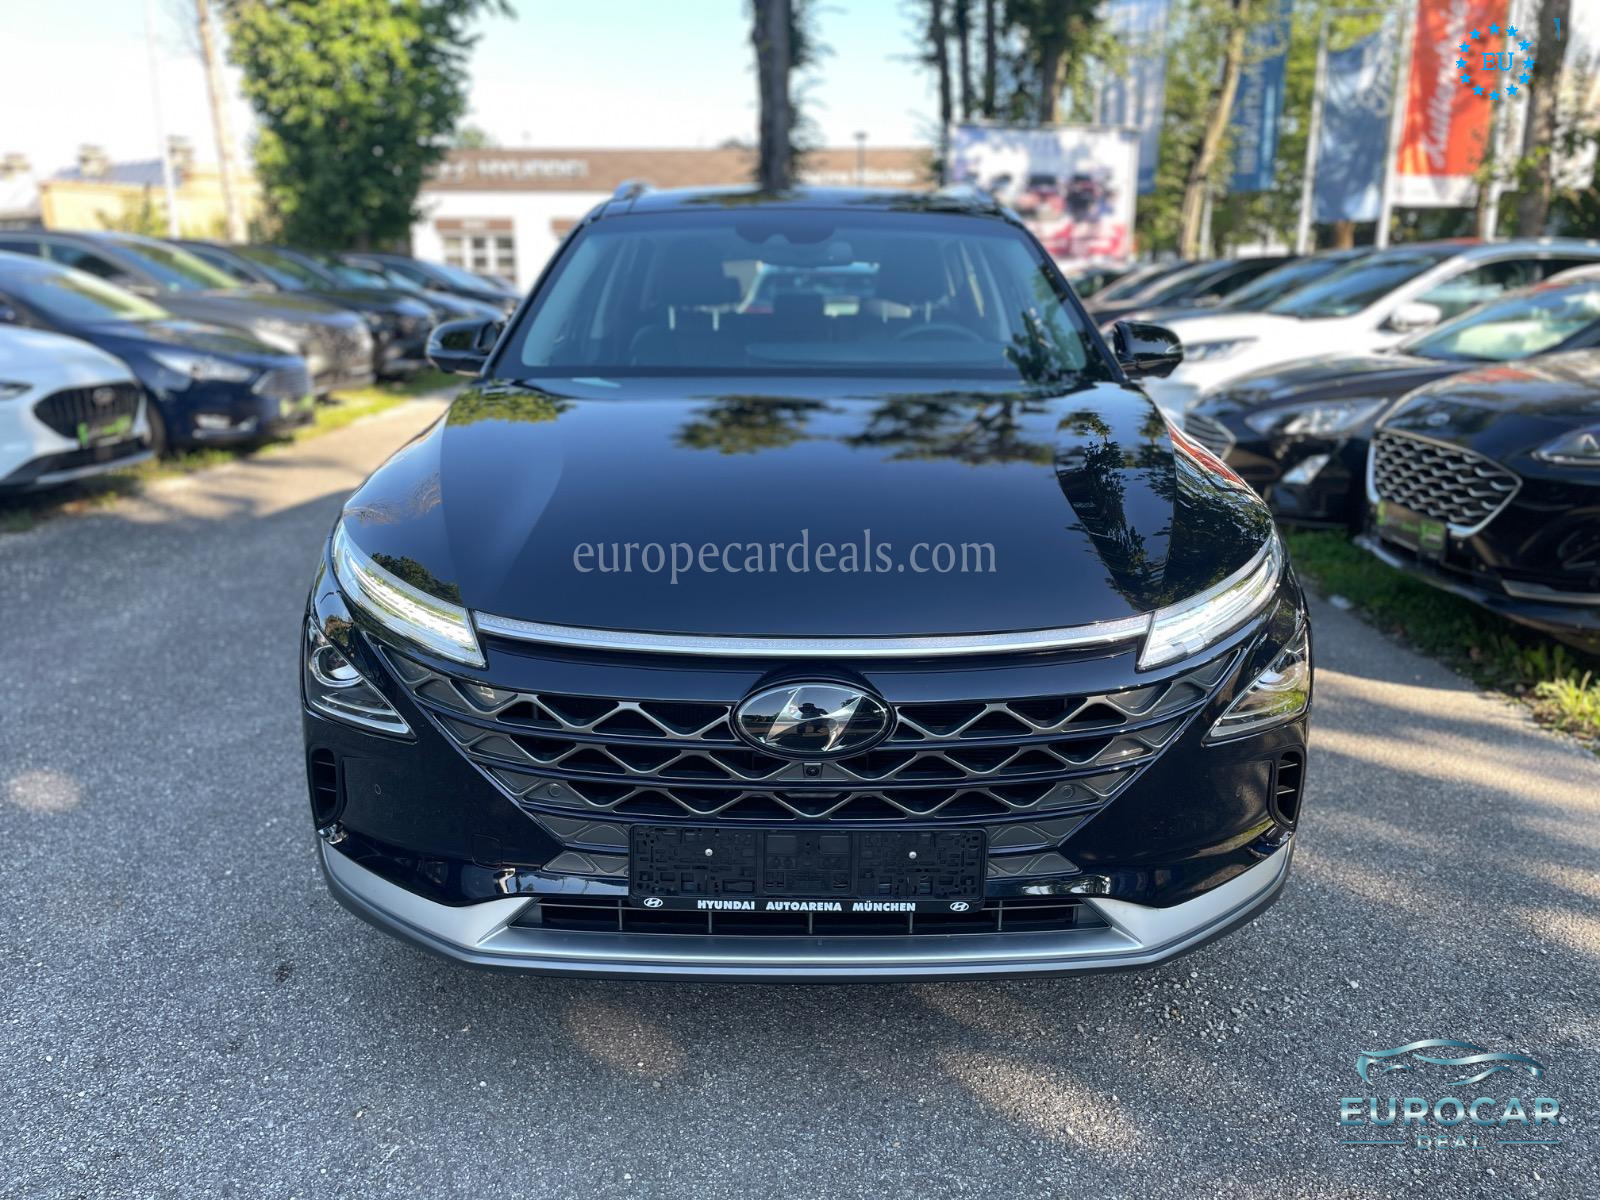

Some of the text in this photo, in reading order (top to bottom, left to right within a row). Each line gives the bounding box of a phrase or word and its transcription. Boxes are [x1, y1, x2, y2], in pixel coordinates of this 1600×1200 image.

[697, 900, 915, 912] HYUNDAI AUTOARENA MÜNCHEN
